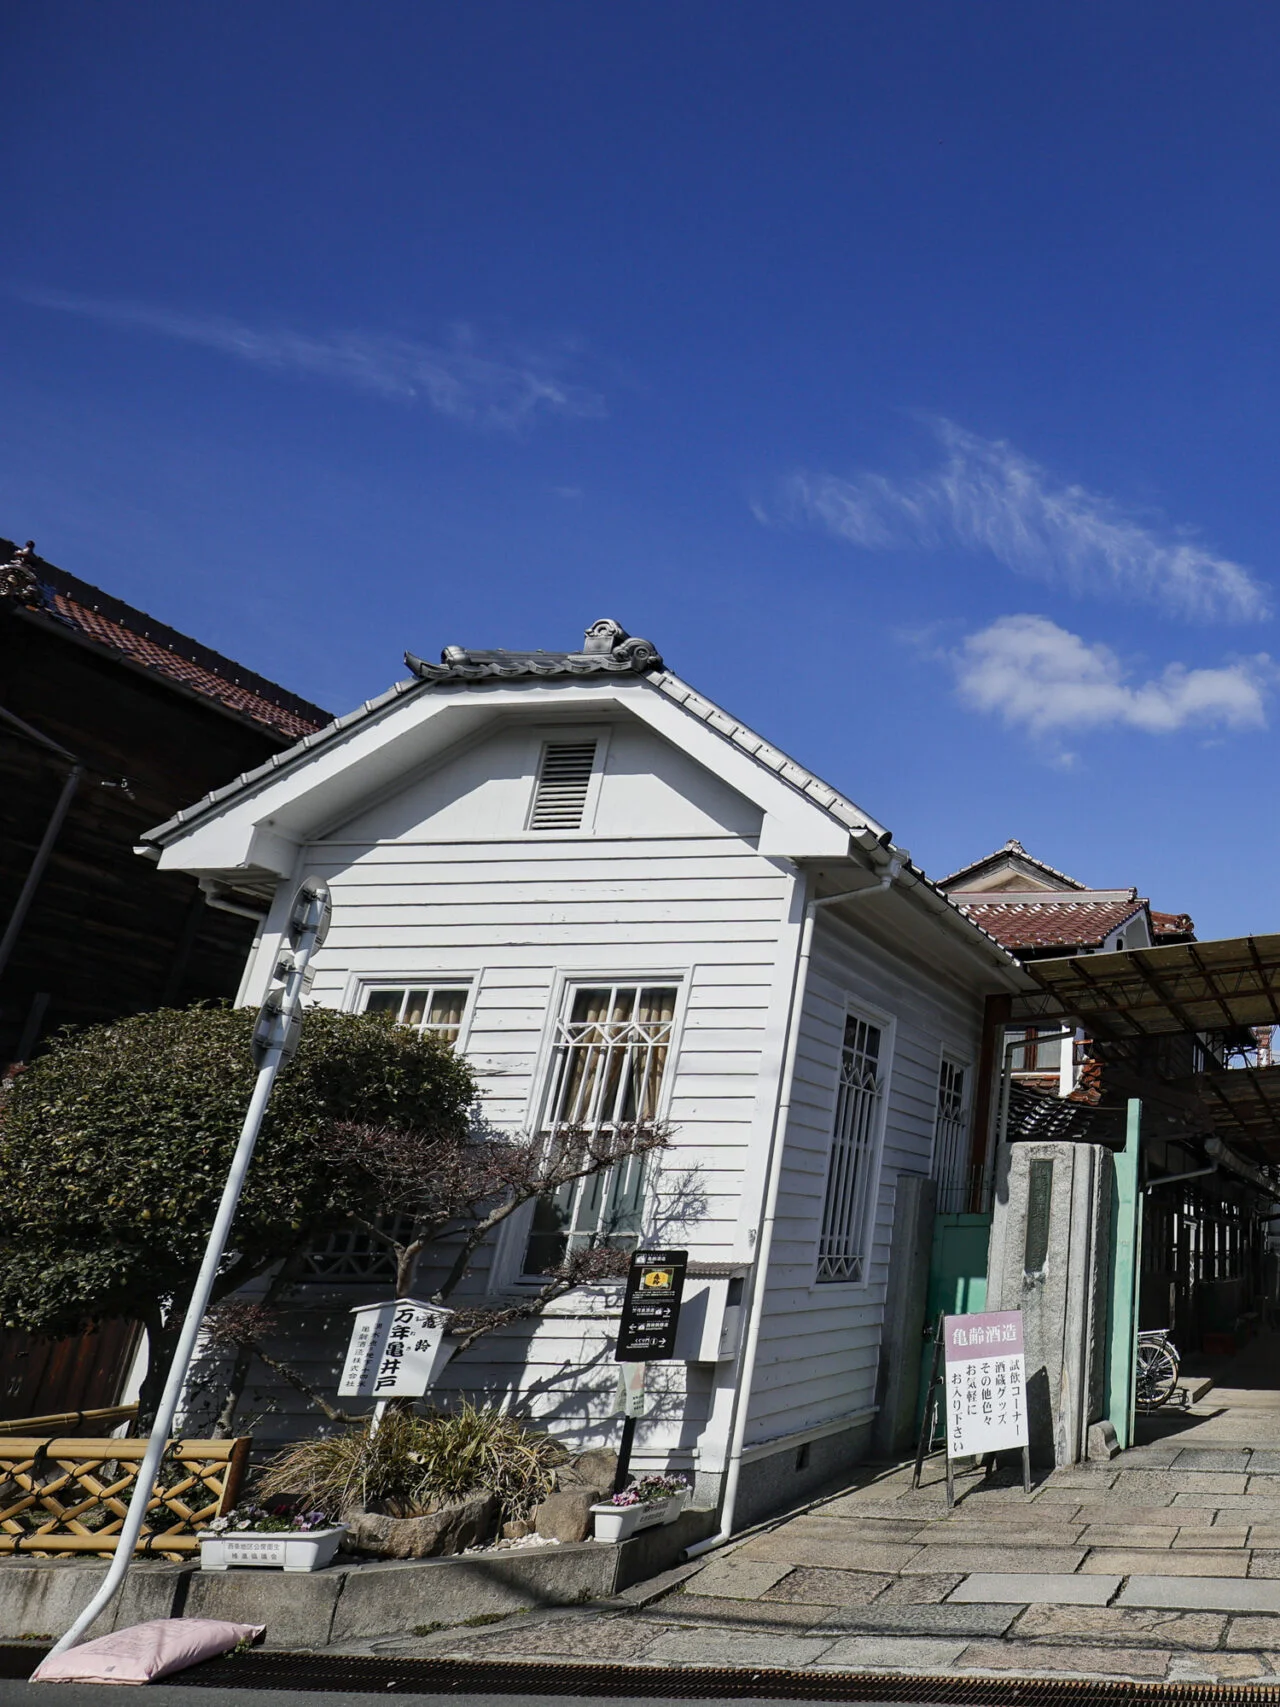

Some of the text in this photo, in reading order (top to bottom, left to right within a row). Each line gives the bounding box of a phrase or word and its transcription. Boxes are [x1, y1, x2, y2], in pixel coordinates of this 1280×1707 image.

[952, 1323, 1018, 1347] 亀齢酒造
[950, 1372, 965, 1453] お入り下さい
[965, 1364, 978, 1417] お気軽に
[980, 1362, 993, 1427] その他色々
[994, 1361, 1008, 1426] 酒蔵グッズ
[1009, 1359, 1023, 1437] 試飲コーナー
